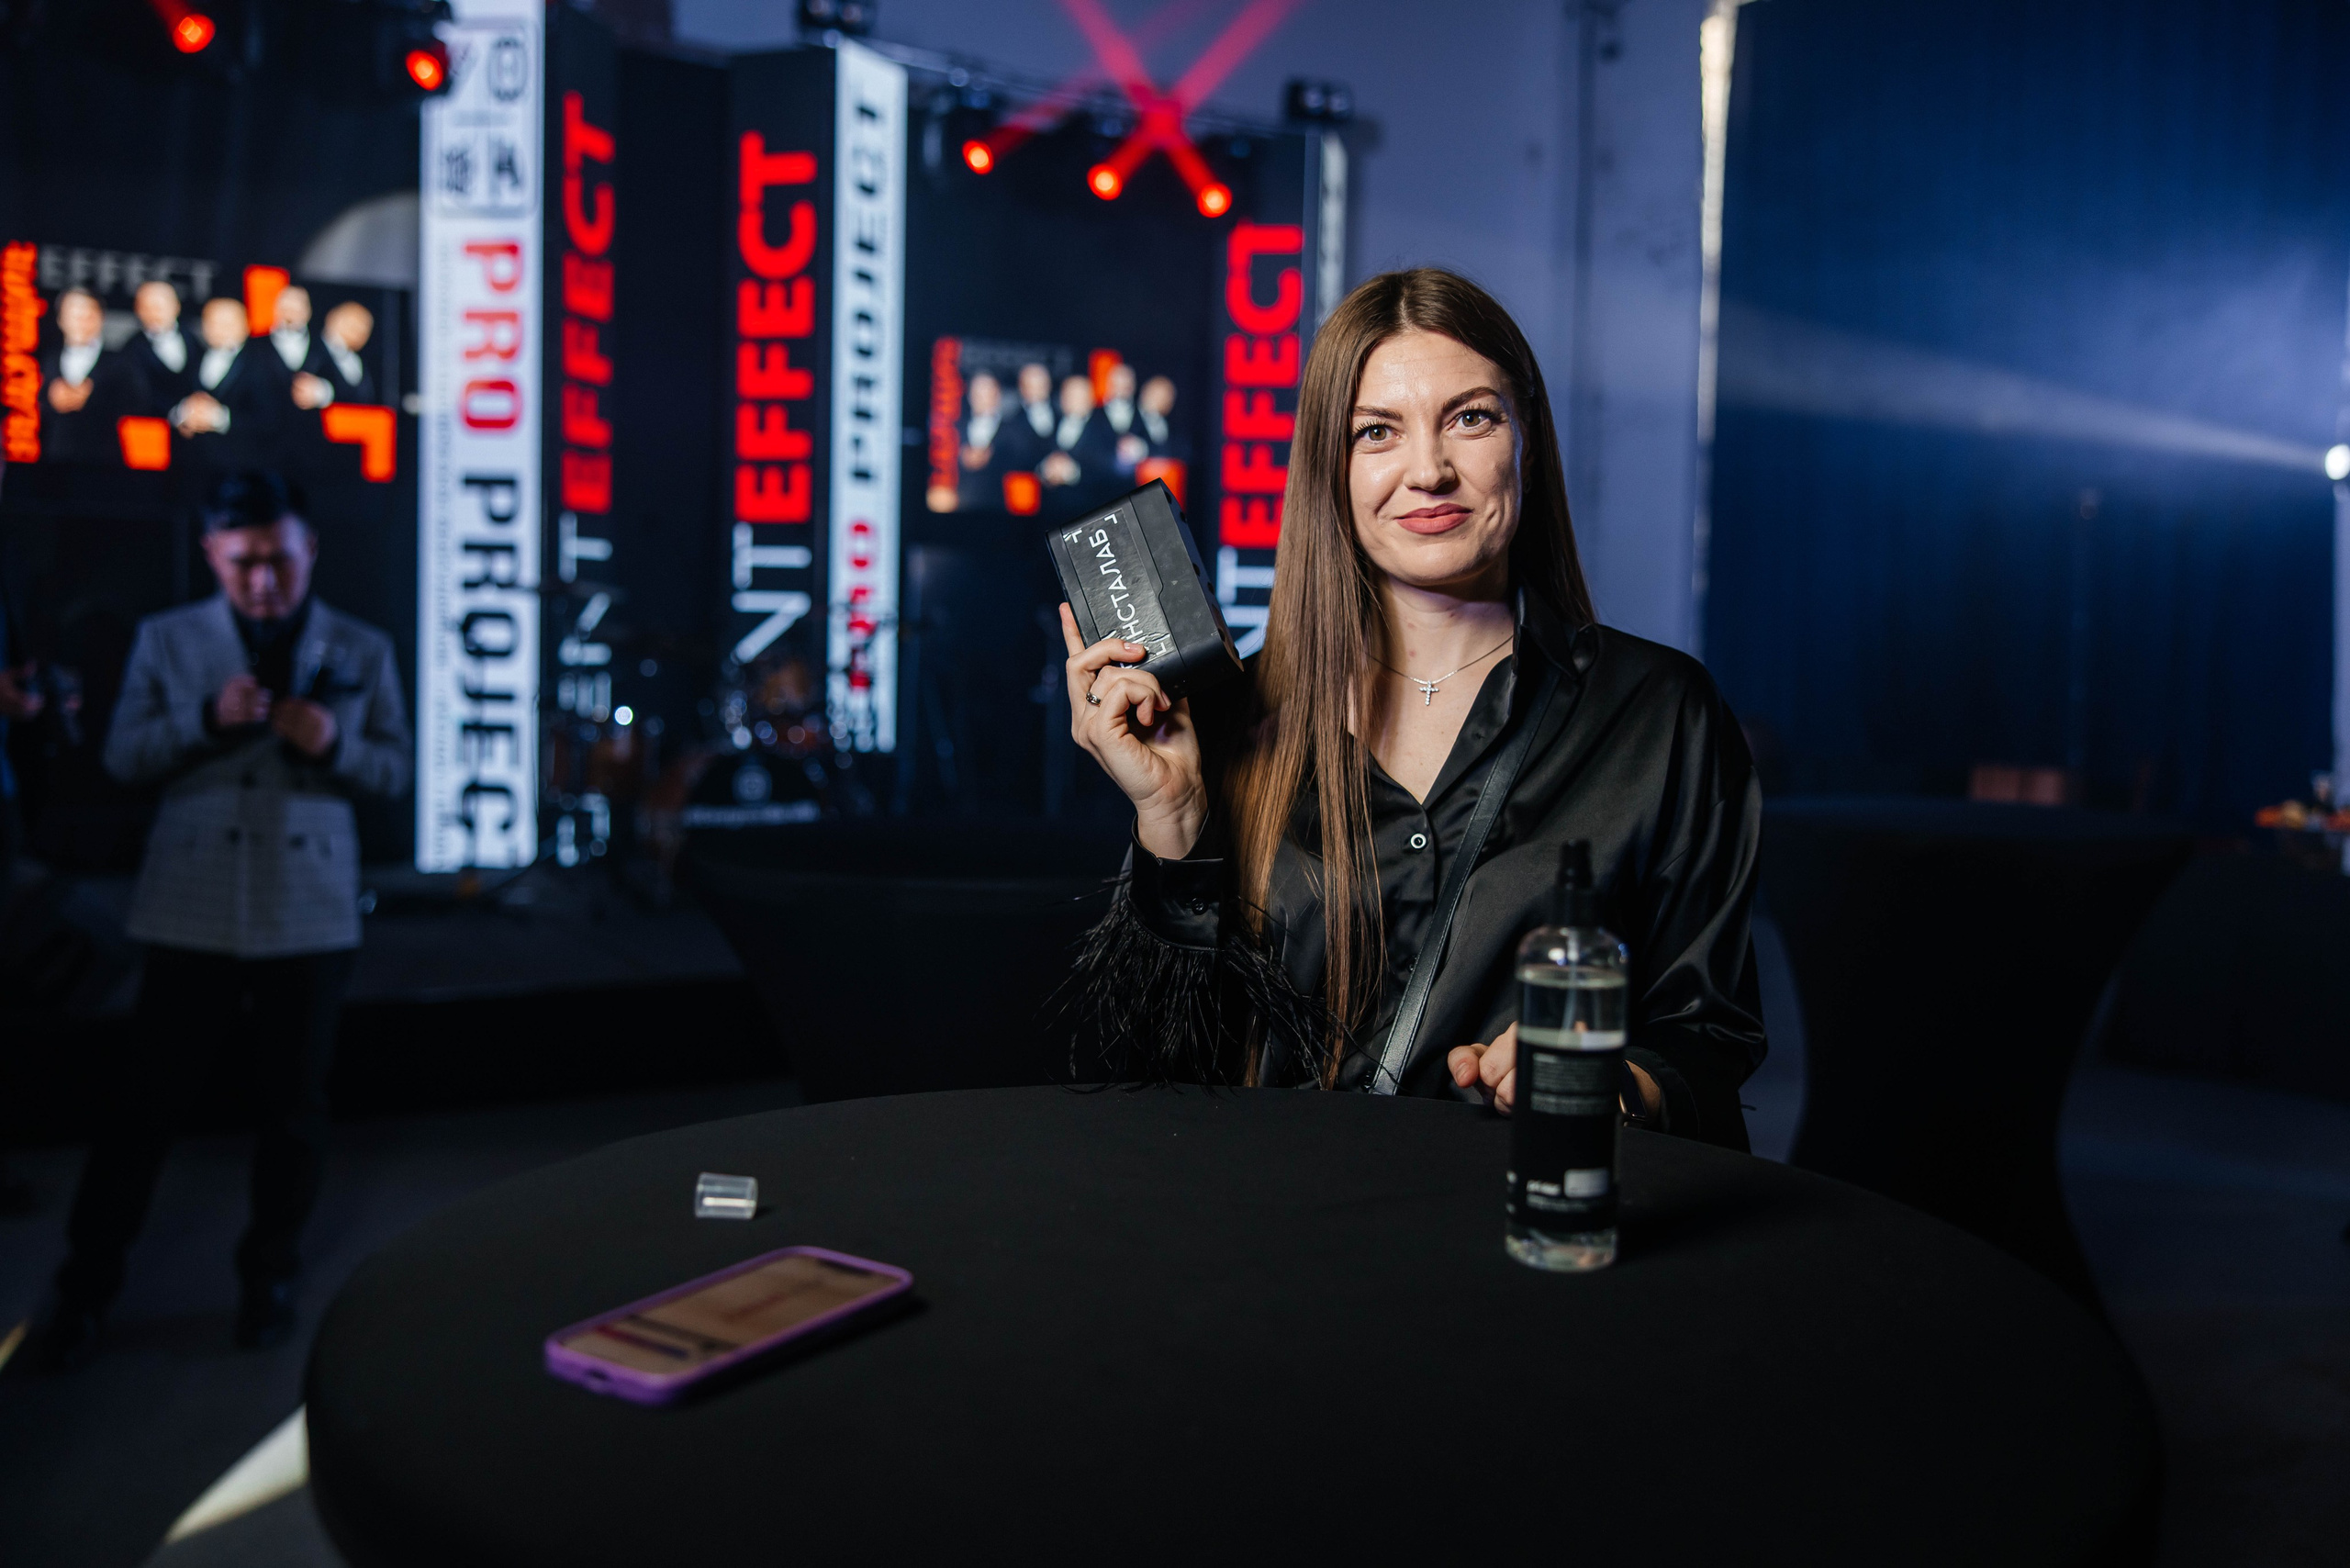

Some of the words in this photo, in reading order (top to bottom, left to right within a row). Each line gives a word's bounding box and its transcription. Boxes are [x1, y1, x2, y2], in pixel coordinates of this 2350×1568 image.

[463, 237, 523, 431] PRO
[459, 474, 521, 865] PROJEC
[1089, 528, 1149, 651] НСТАЛАБ
